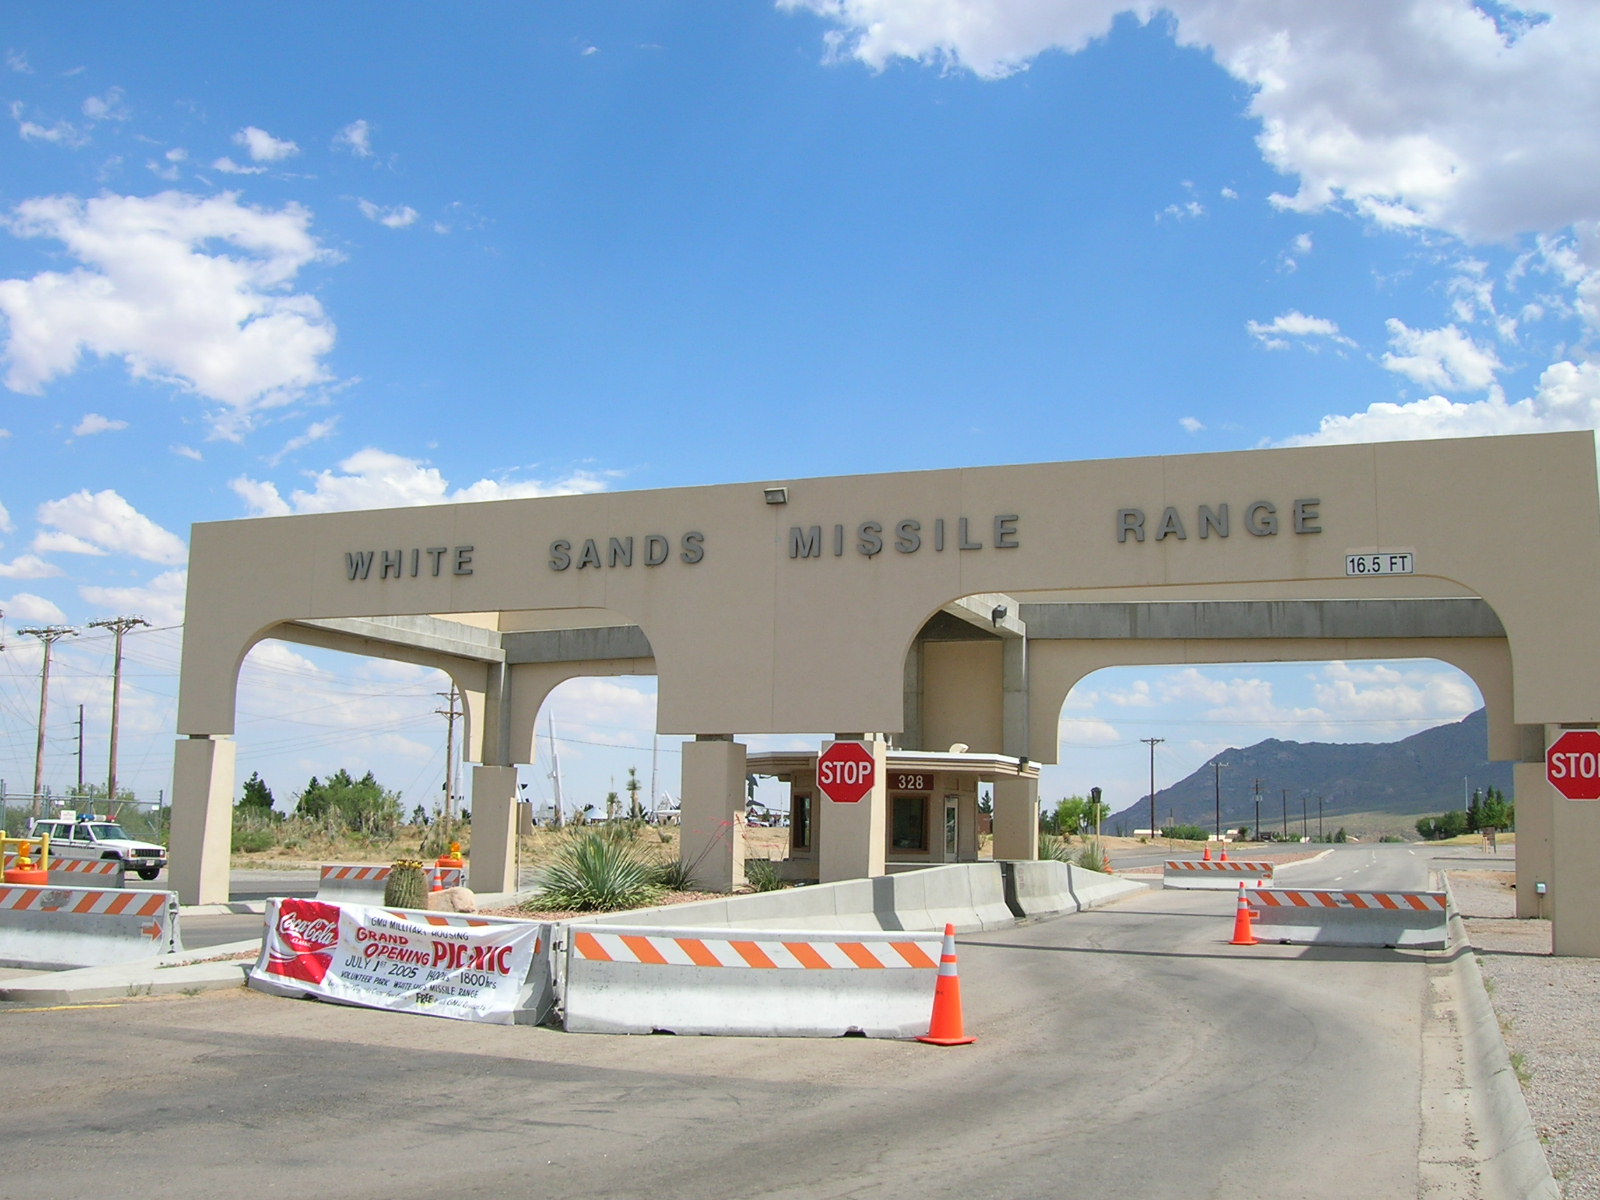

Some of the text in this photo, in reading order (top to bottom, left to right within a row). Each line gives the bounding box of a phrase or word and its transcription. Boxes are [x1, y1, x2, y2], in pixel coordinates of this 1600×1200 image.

[345, 498, 1322, 580] WHITE SANDS MISSILE RANGE
[1348, 555, 1408, 574] 16.5 FT
[821, 761, 871, 784] STOP
[1551, 752, 1600, 779] STO
[898, 775, 924, 789] 328
[356, 927, 409, 945] GRAND
[364, 943, 430, 966] OPENING
[345, 955, 371, 971] JULY
[388, 963, 419, 979] 2005
[373, 976, 389, 987] PARK
[429, 984, 456, 996] MISSILE
[415, 992, 434, 1004] FREE
